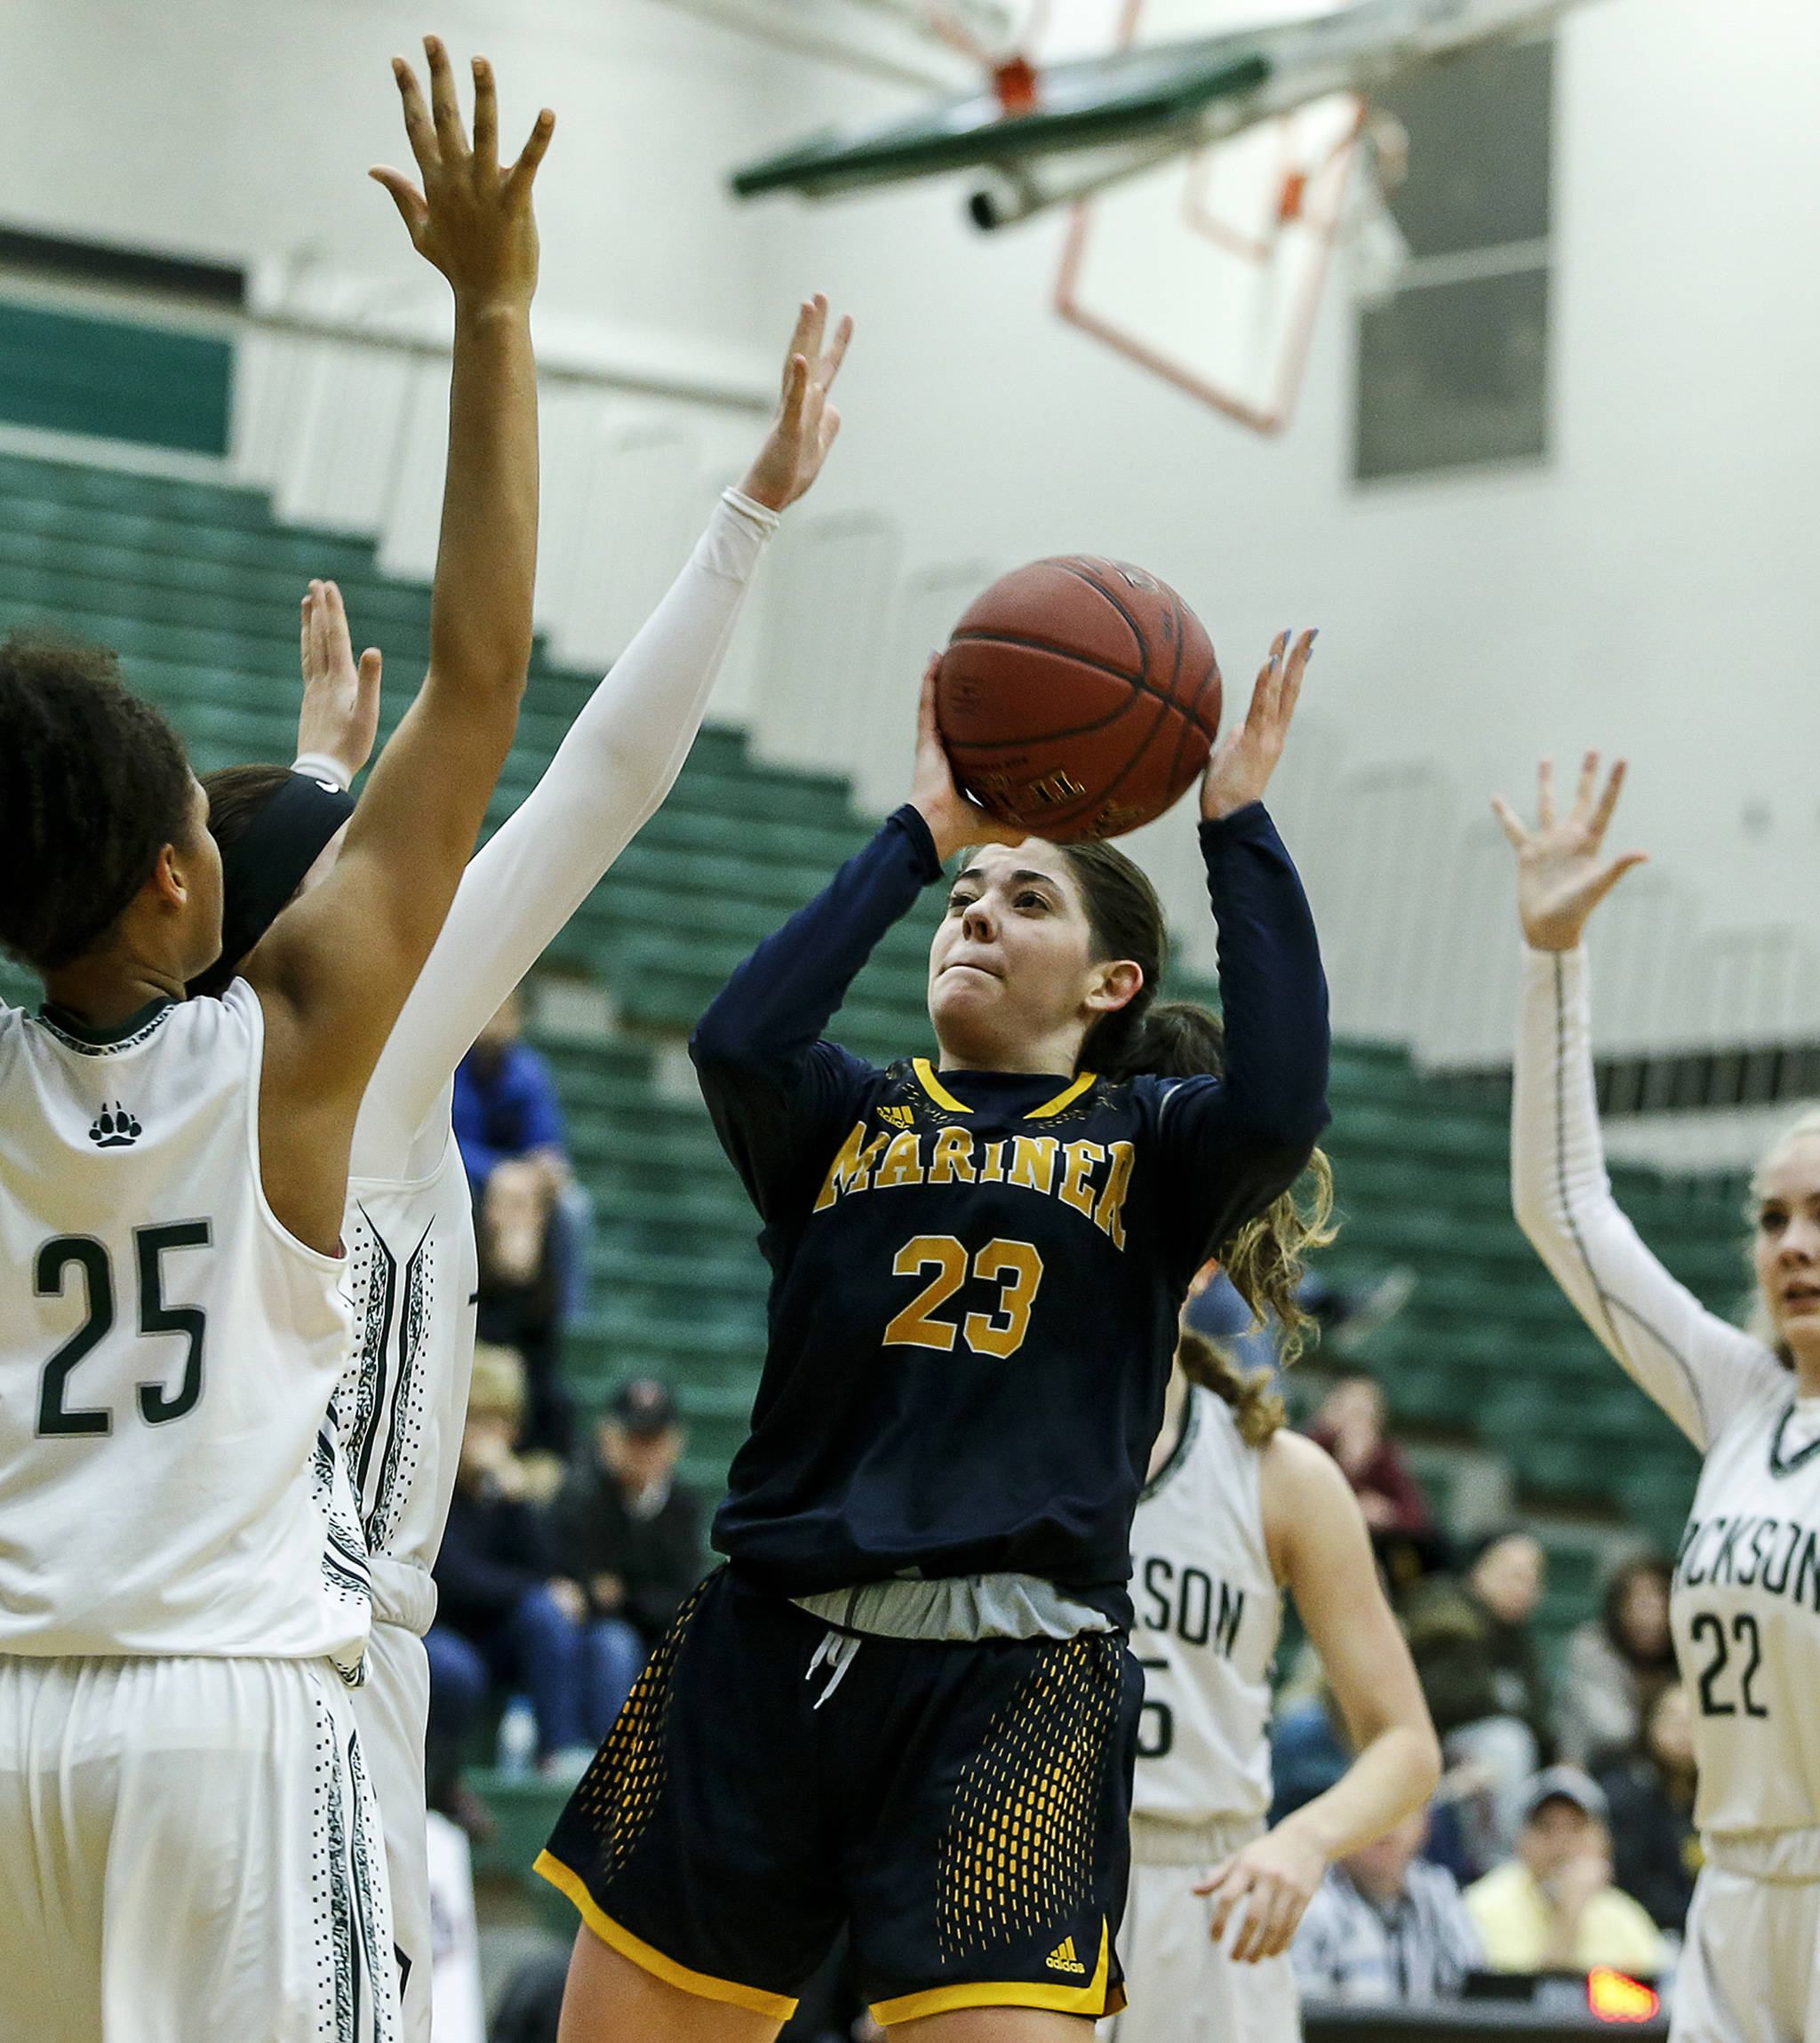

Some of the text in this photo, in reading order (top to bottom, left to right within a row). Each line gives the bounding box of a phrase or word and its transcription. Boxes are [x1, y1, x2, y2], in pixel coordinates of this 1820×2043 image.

[812, 1120, 1135, 1252] MARINER
[32, 1216, 213, 1440] 25
[882, 1234, 1043, 1359] 23
[1690, 1612, 1768, 1719] 22
[1045, 1957, 1086, 1975] adidas
